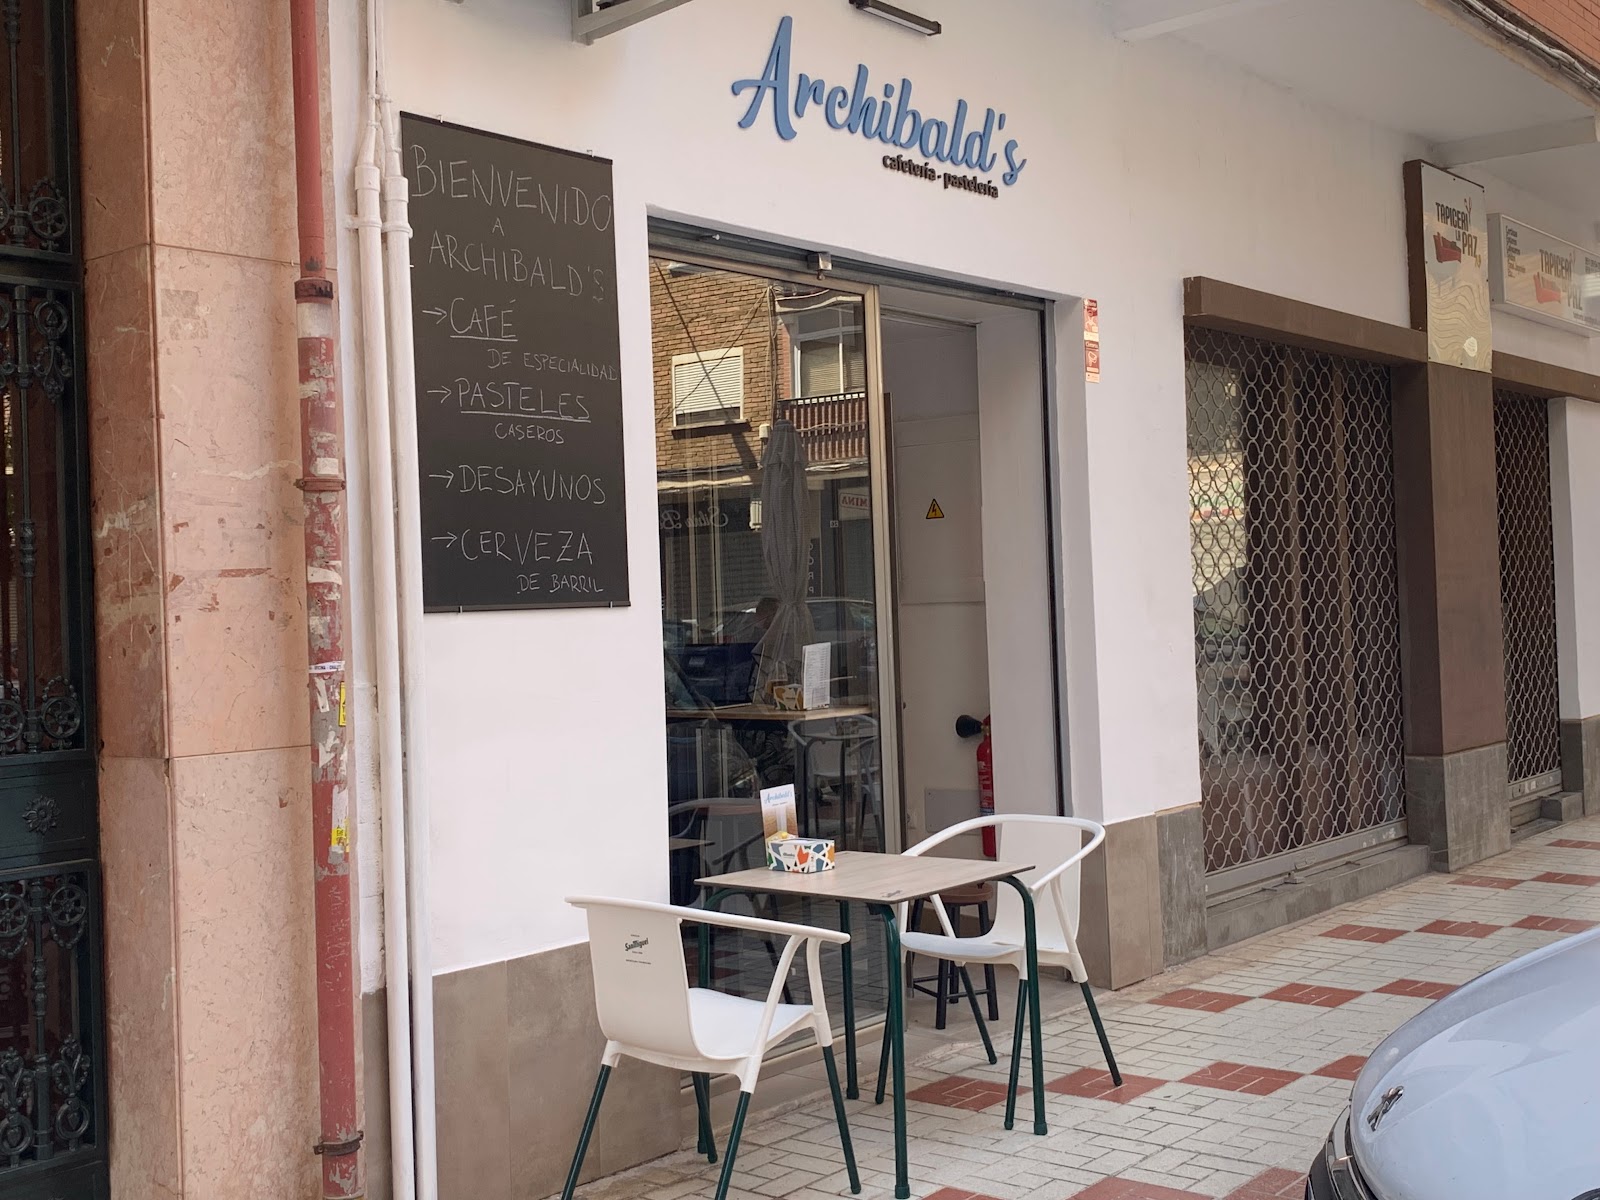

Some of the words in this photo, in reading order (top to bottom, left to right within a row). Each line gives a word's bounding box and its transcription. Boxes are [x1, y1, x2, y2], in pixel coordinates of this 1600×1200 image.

[731, 15, 1027, 186] Archibald's
[410, 144, 610, 232] BIENVENIDO
[492, 217, 505, 237] A
[1462, 232, 1478, 257] PAZ
[429, 230, 605, 302] ARCHIBALD'S
[450, 297, 517, 340] CAFÉ
[487, 348, 511, 369] DE
[523, 352, 618, 381] ESPECIALIDAD
[454, 377, 591, 420] PASTELES
[494, 422, 565, 444] CASEROS
[458, 464, 606, 505] DESAYUNOS
[461, 529, 593, 565] CERVEZA
[516, 573, 541, 594] DE
[549, 574, 604, 593] BARRIL
